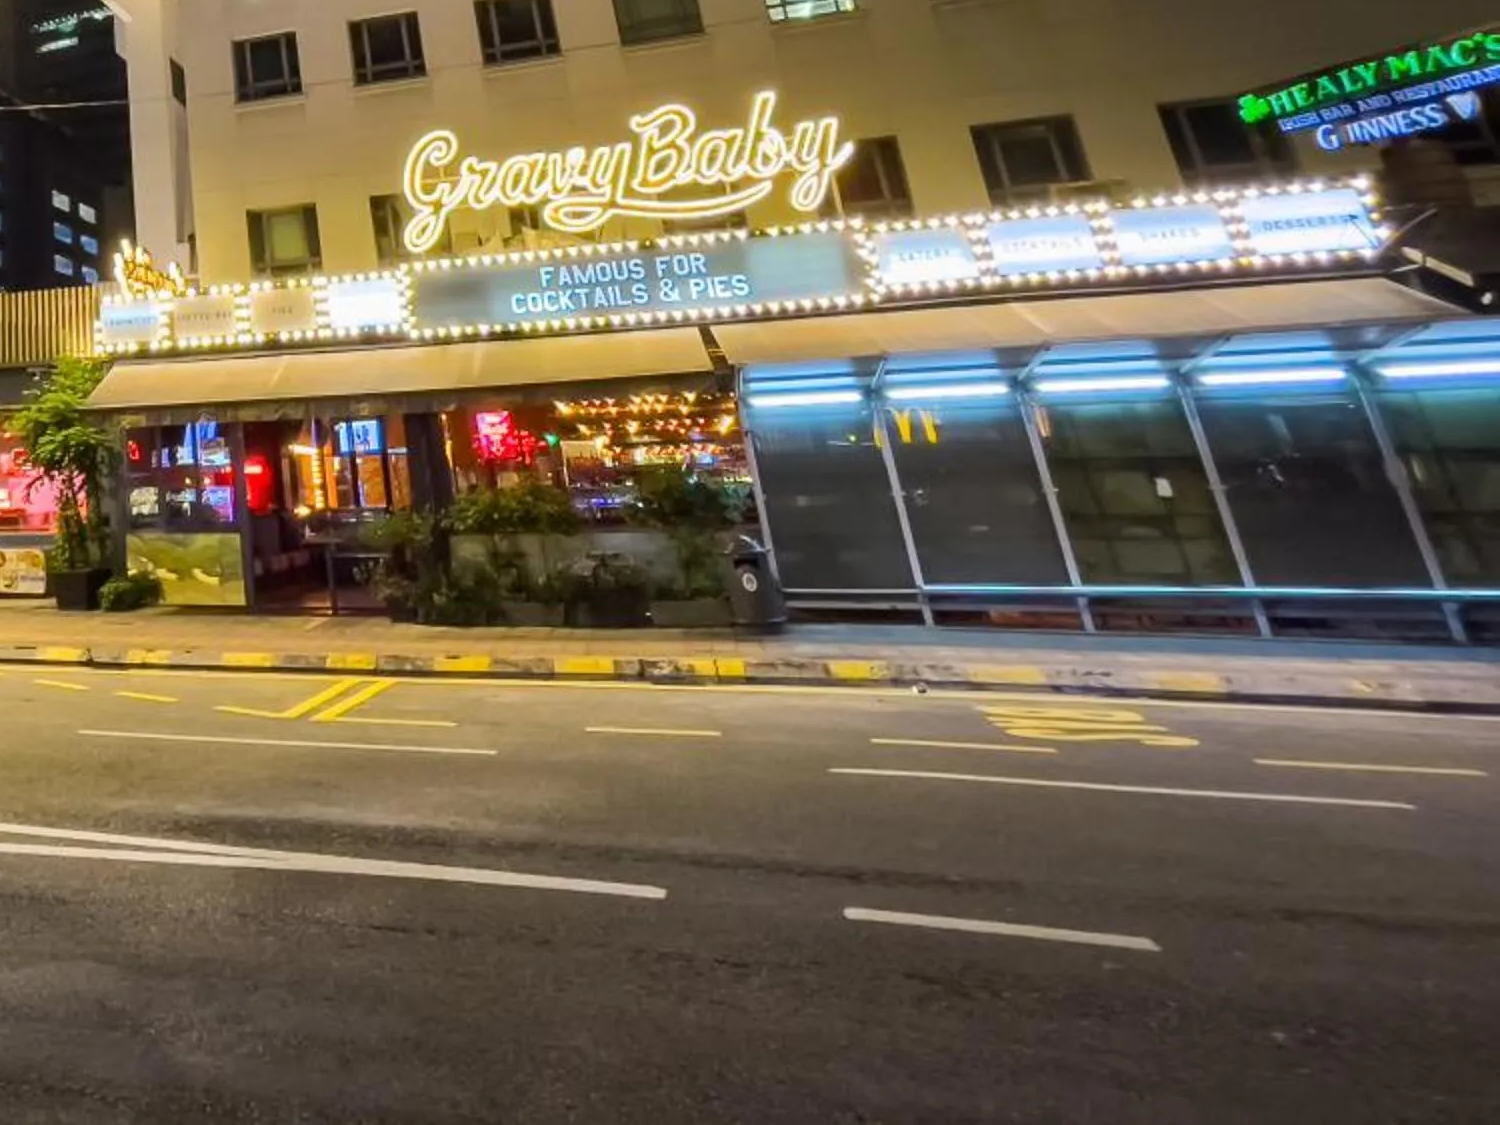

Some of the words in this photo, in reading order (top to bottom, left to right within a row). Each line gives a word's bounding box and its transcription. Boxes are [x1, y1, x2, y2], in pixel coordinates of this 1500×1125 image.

[1267, 62, 1379, 117] HEALY
[1384, 32, 1500, 80] MAC'S
[1357, 93, 1394, 113] AND
[1392, 63, 1500, 106] RESTAURAN
[403, 129, 650, 254] Gravy
[629, 90, 855, 212] Baby
[510, 283, 650, 314] COCKTAILS
[658, 277, 682, 303] &
[689, 274, 751, 301] PIES
[539, 259, 646, 289] FAMOUS
[655, 253, 708, 278] FOR
